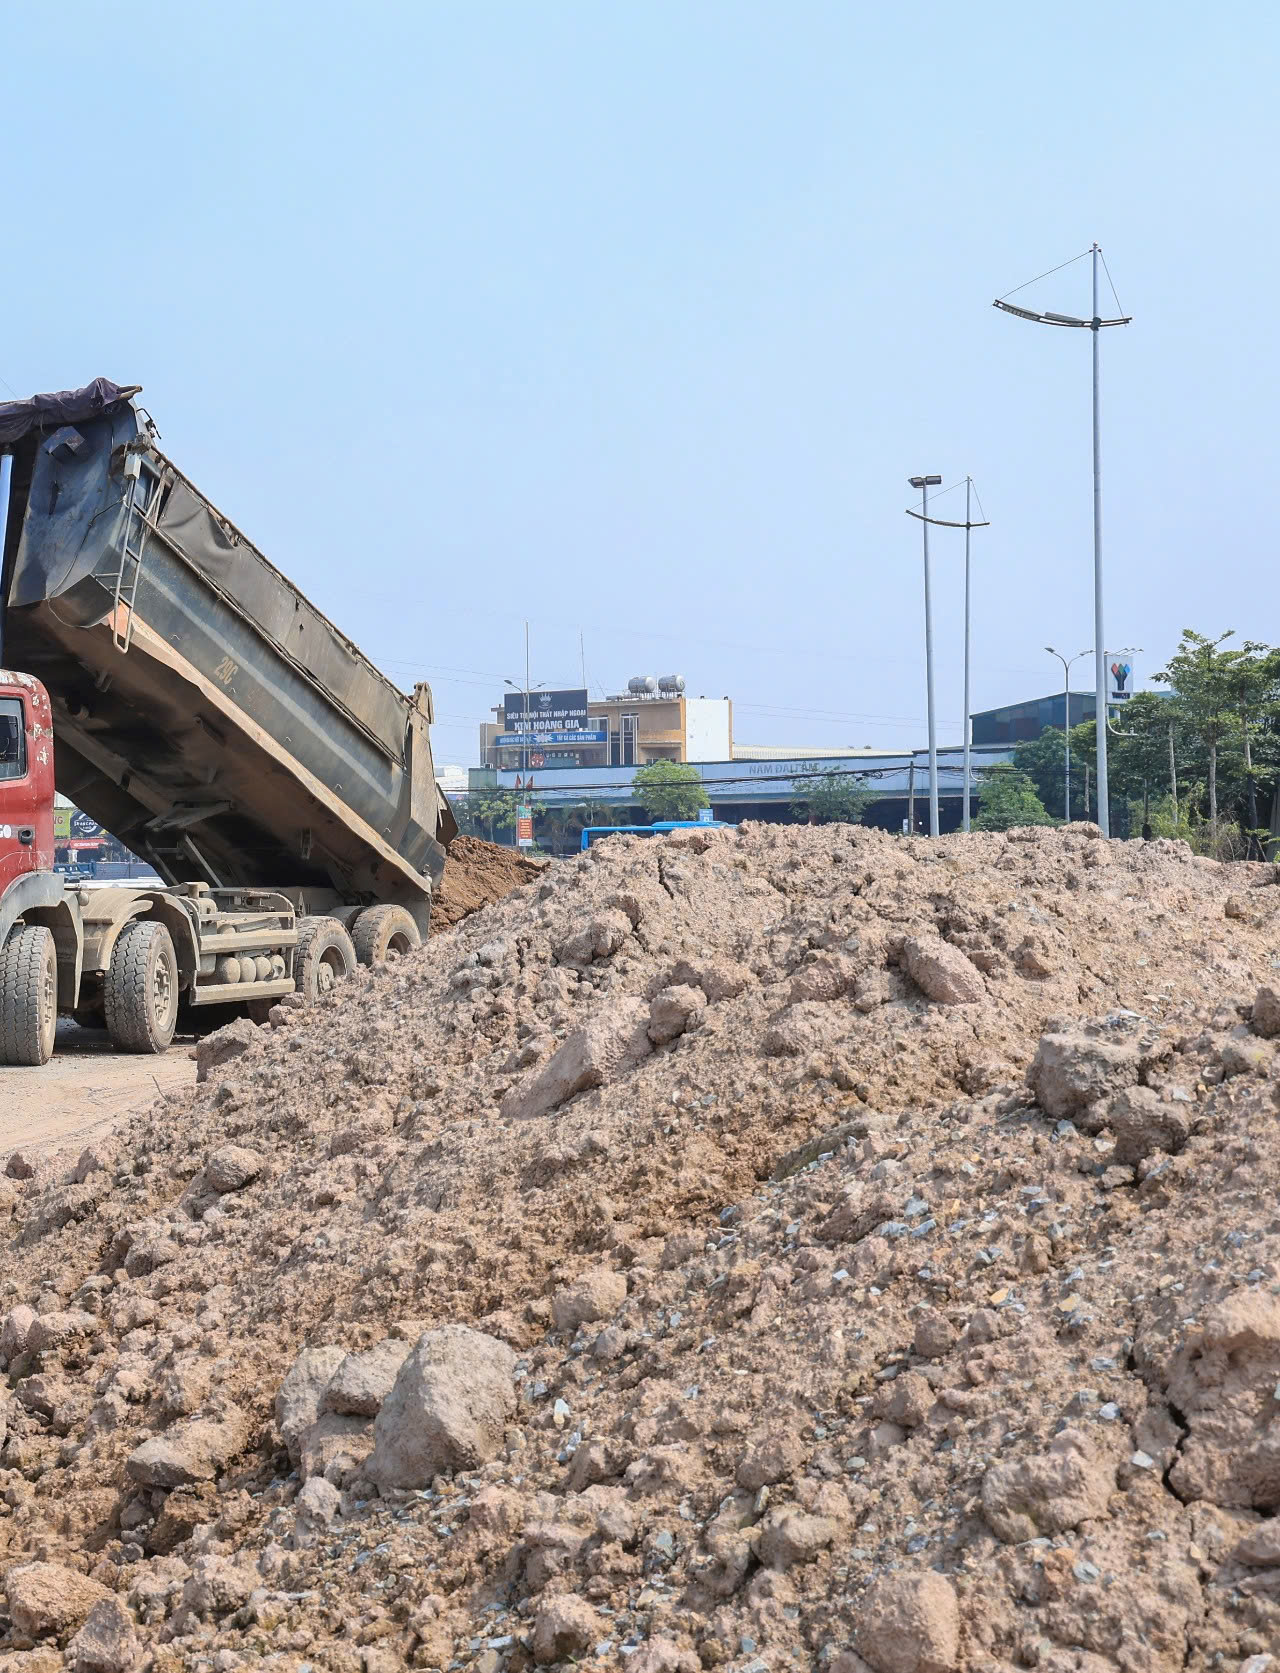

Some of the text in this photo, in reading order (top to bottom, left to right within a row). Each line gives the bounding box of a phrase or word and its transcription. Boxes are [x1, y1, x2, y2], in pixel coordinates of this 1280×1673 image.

[215, 656, 238, 685] 29C
[564, 720, 580, 729] GIA
[749, 763, 773, 775] NAM
